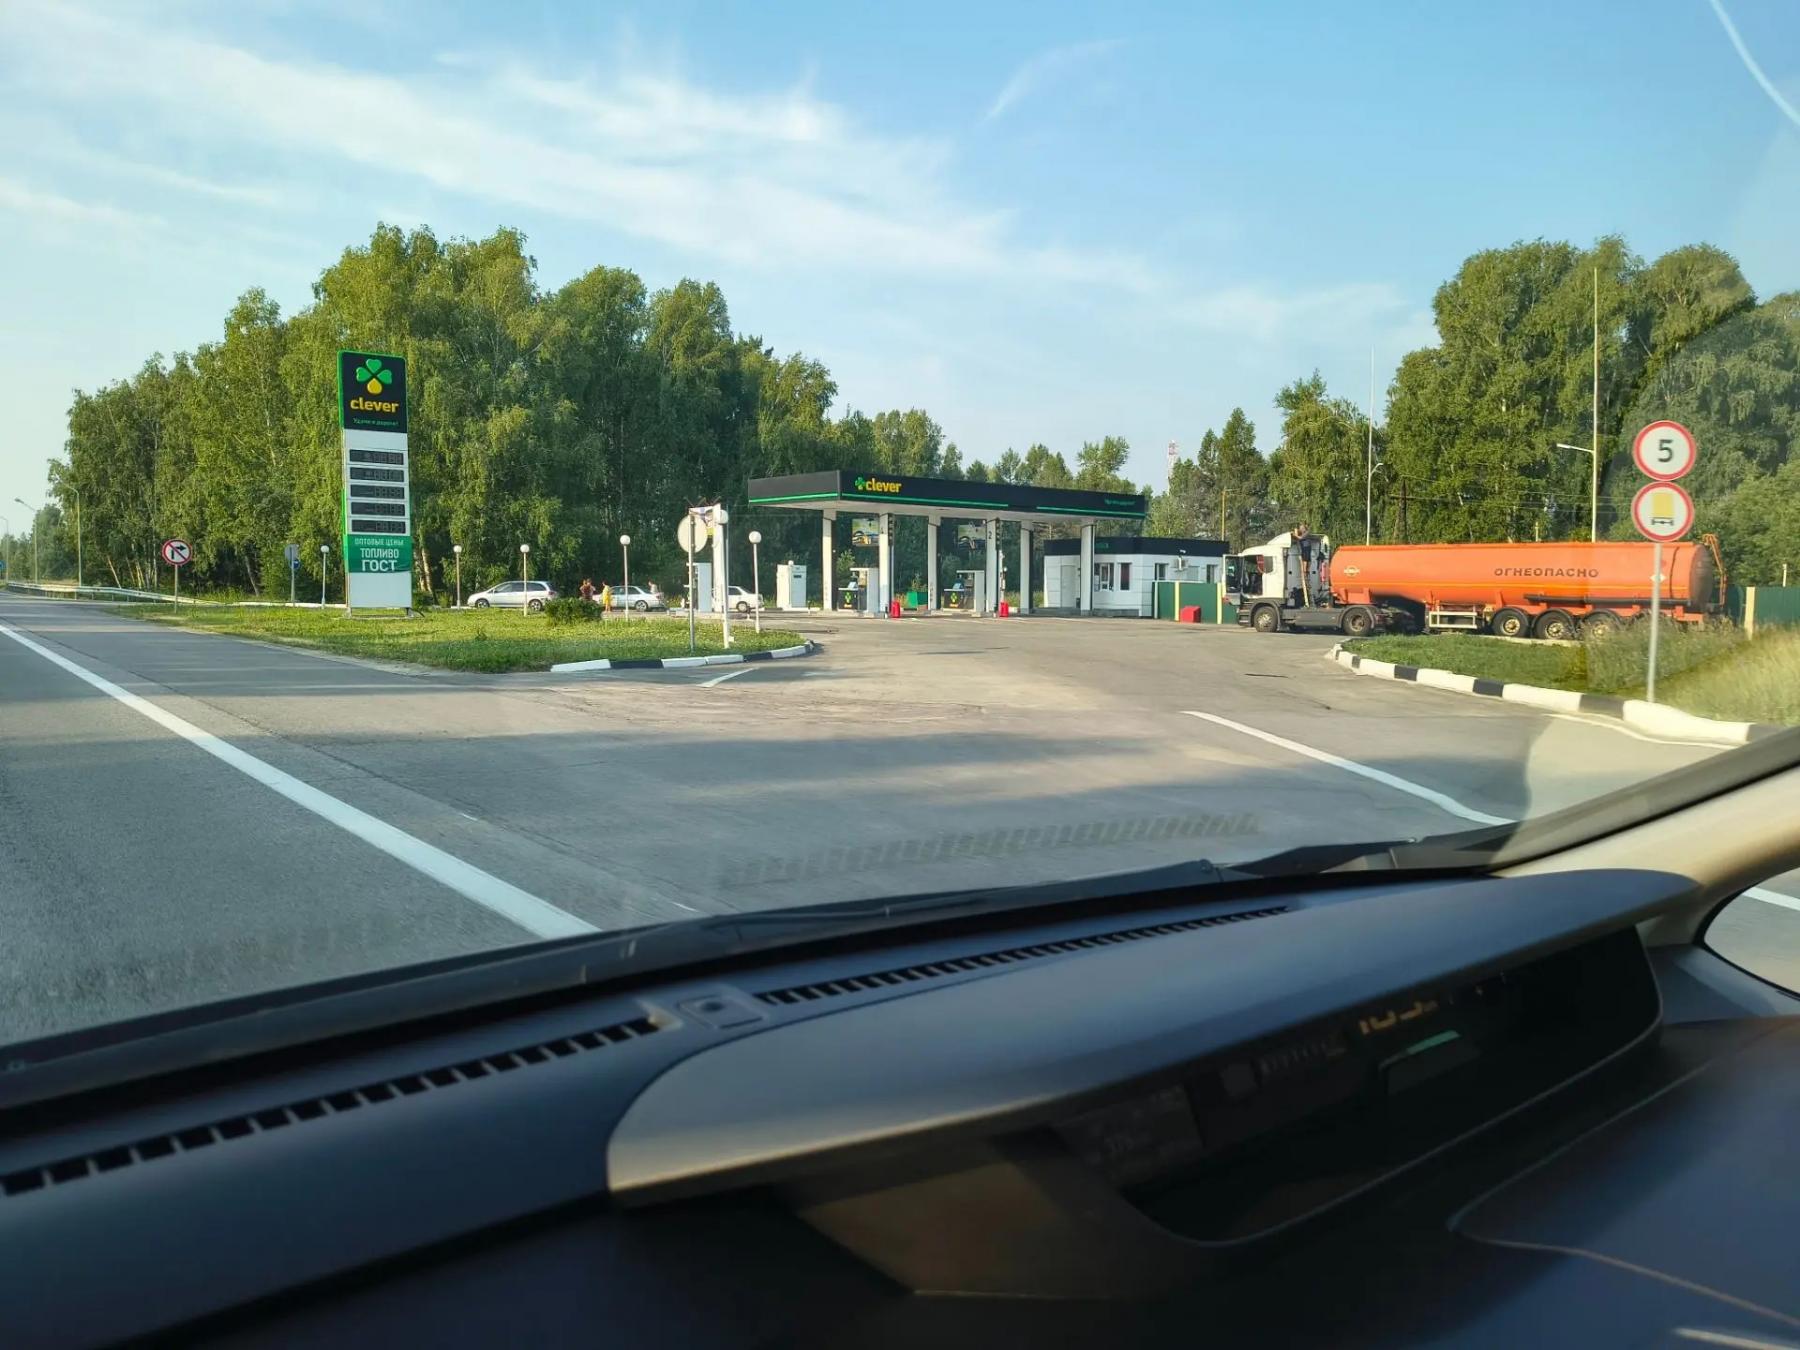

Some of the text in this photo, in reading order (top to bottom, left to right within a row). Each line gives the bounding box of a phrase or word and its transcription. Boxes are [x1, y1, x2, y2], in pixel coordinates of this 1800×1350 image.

[350, 397, 399, 413] clever
[1658, 439, 1673, 463] 5
[865, 477, 902, 493] clever
[386, 538, 404, 546] ЦЕНЫ
[360, 548, 400, 559] ТОПЛИВО
[361, 559, 398, 572] ГОСТ
[1494, 567, 1599, 578] ОГНЕОПАСНО
